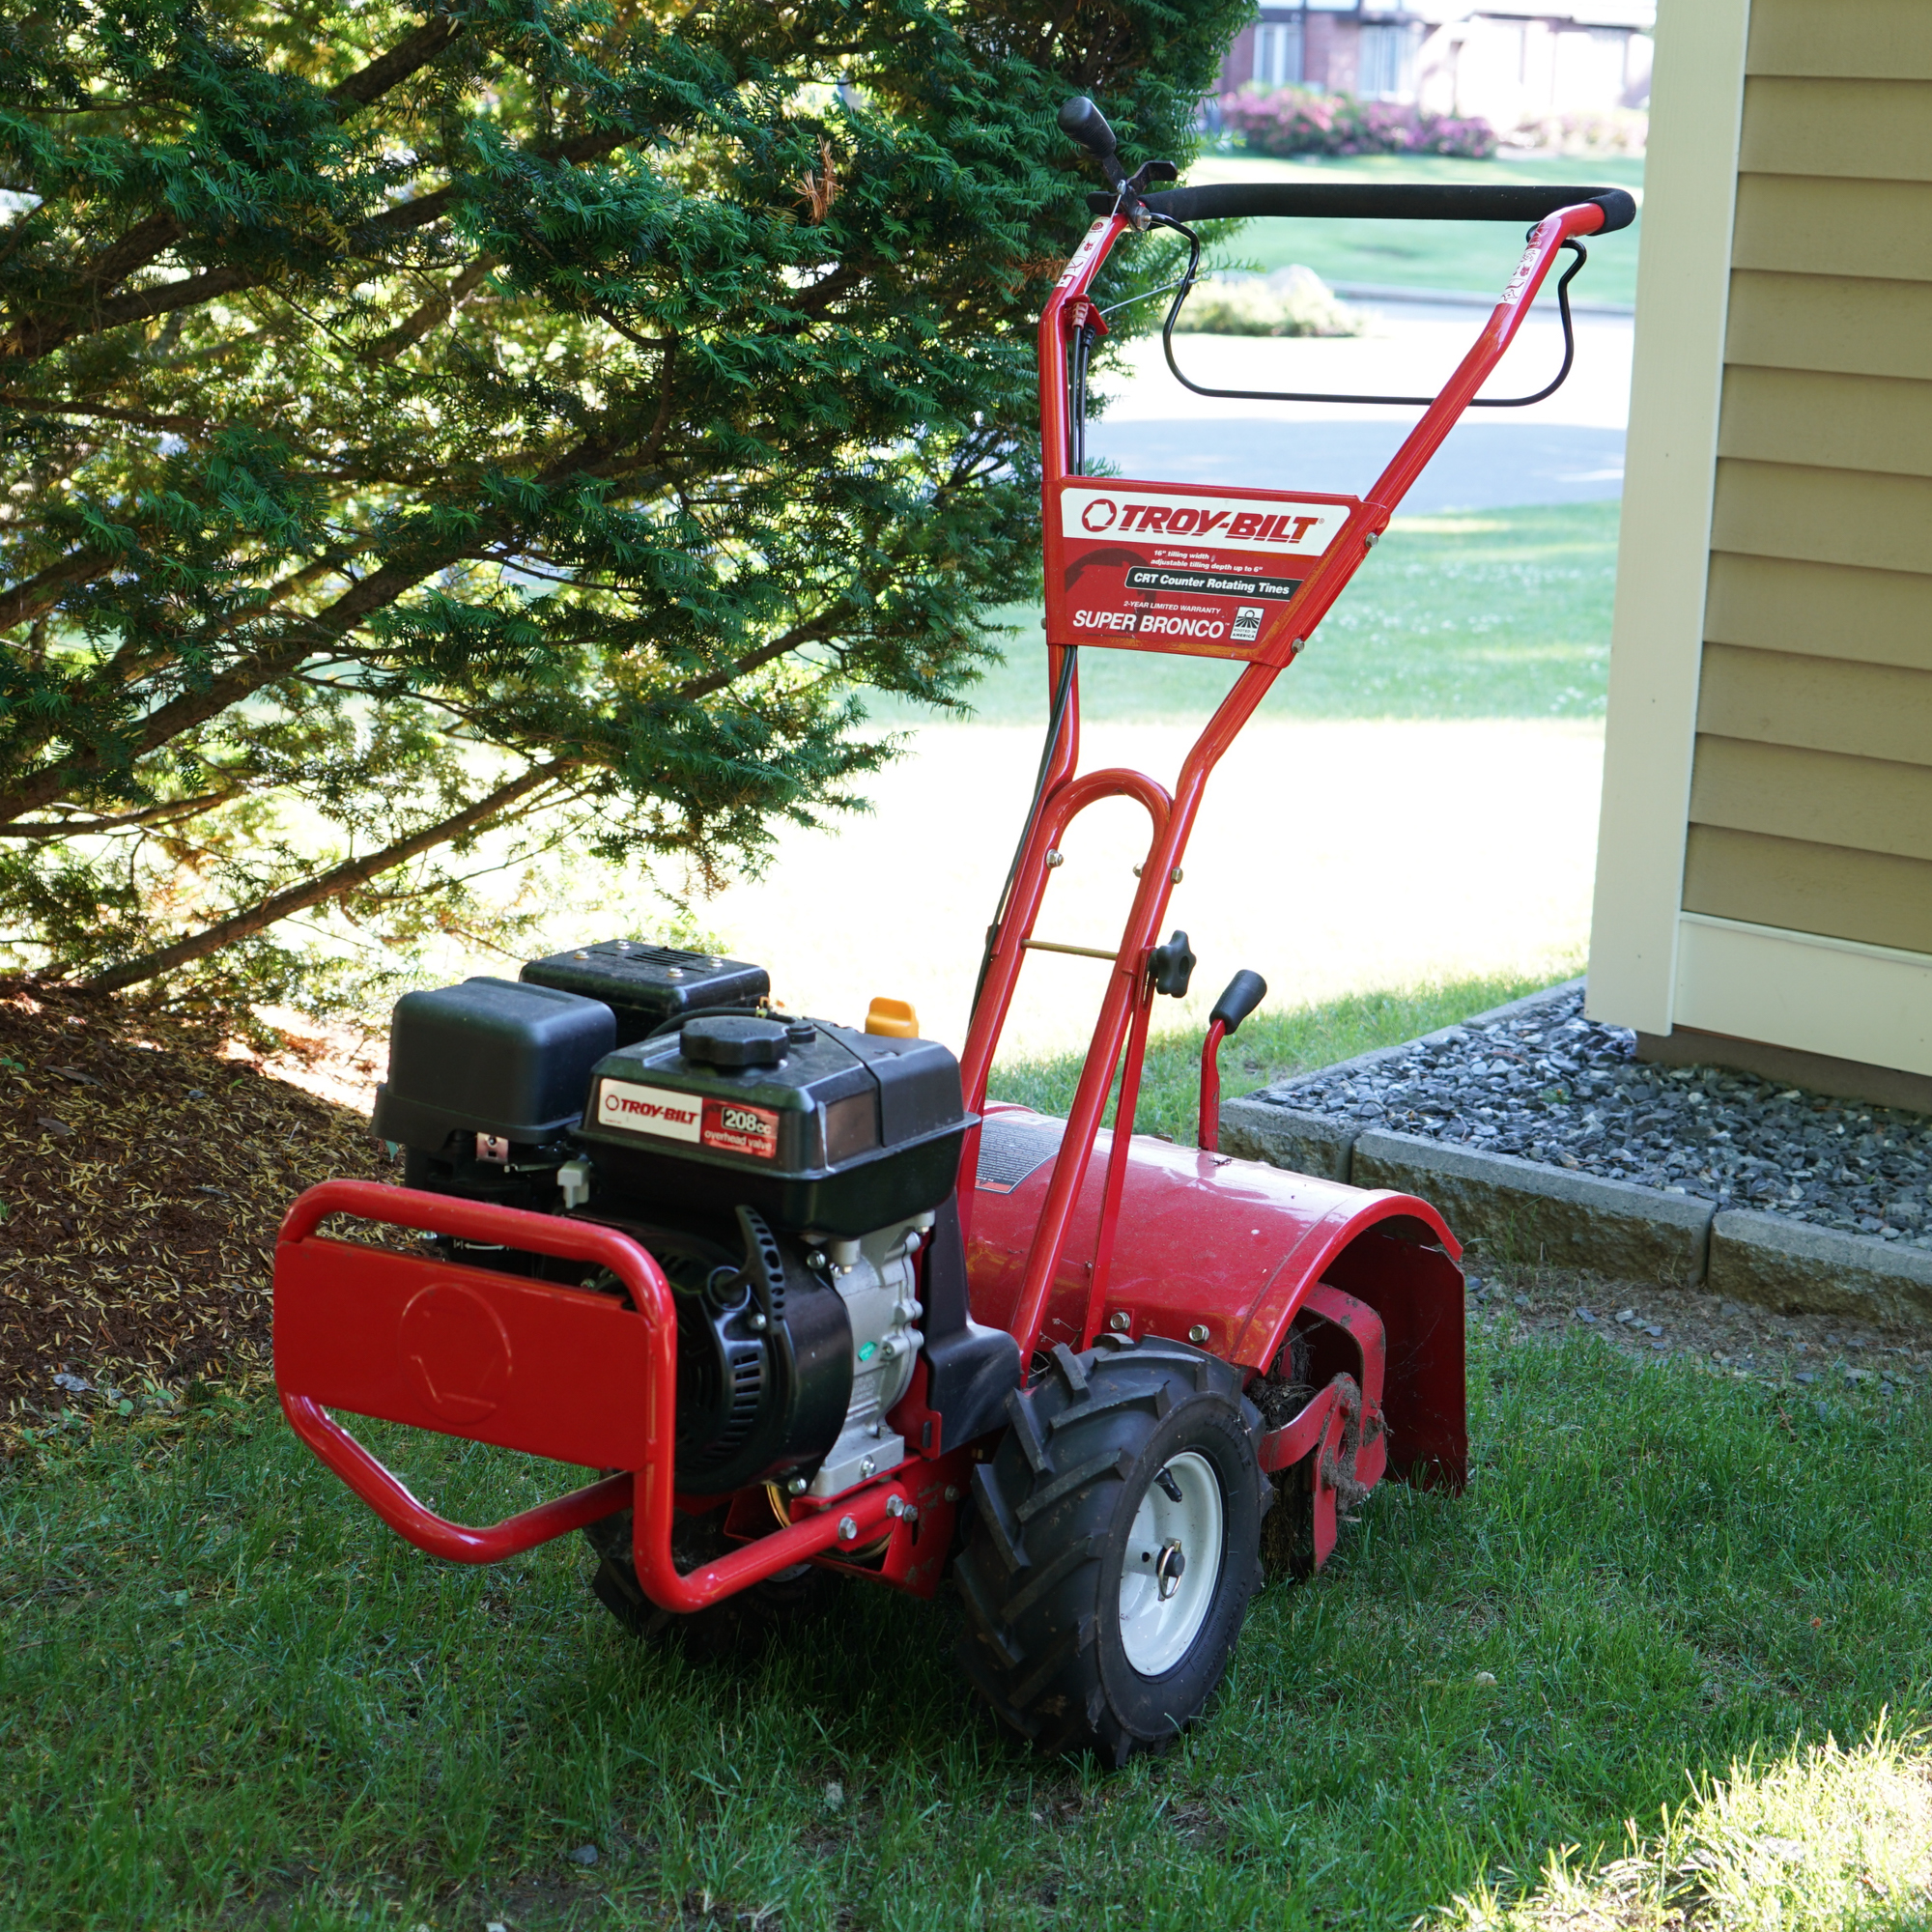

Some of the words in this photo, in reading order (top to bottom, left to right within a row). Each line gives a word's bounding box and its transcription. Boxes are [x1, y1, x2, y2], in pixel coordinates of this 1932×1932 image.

[1118, 504, 1320, 544] TROY-BILT
[1151, 558, 1188, 567] adjustable
[1189, 560, 1209, 570] tilling
[1167, 551, 1188, 559] tilling
[1133, 572, 1159, 584] CRT
[1159, 575, 1206, 588] Counter
[1207, 578, 1256, 593] Rotating
[1259, 582, 1290, 595] Tines
[1123, 600, 1150, 609] 2-YEAR
[1150, 602, 1179, 611] LIMITED
[1179, 605, 1222, 614] WARRANTY
[1072, 610, 1137, 632] SUPER
[1139, 614, 1225, 639] BRONCO
[621, 1098, 699, 1125] TROY-BILT
[724, 1110, 772, 1135] 208cc
[704, 1128, 748, 1147] overhead
[748, 1138, 773, 1151] valve
